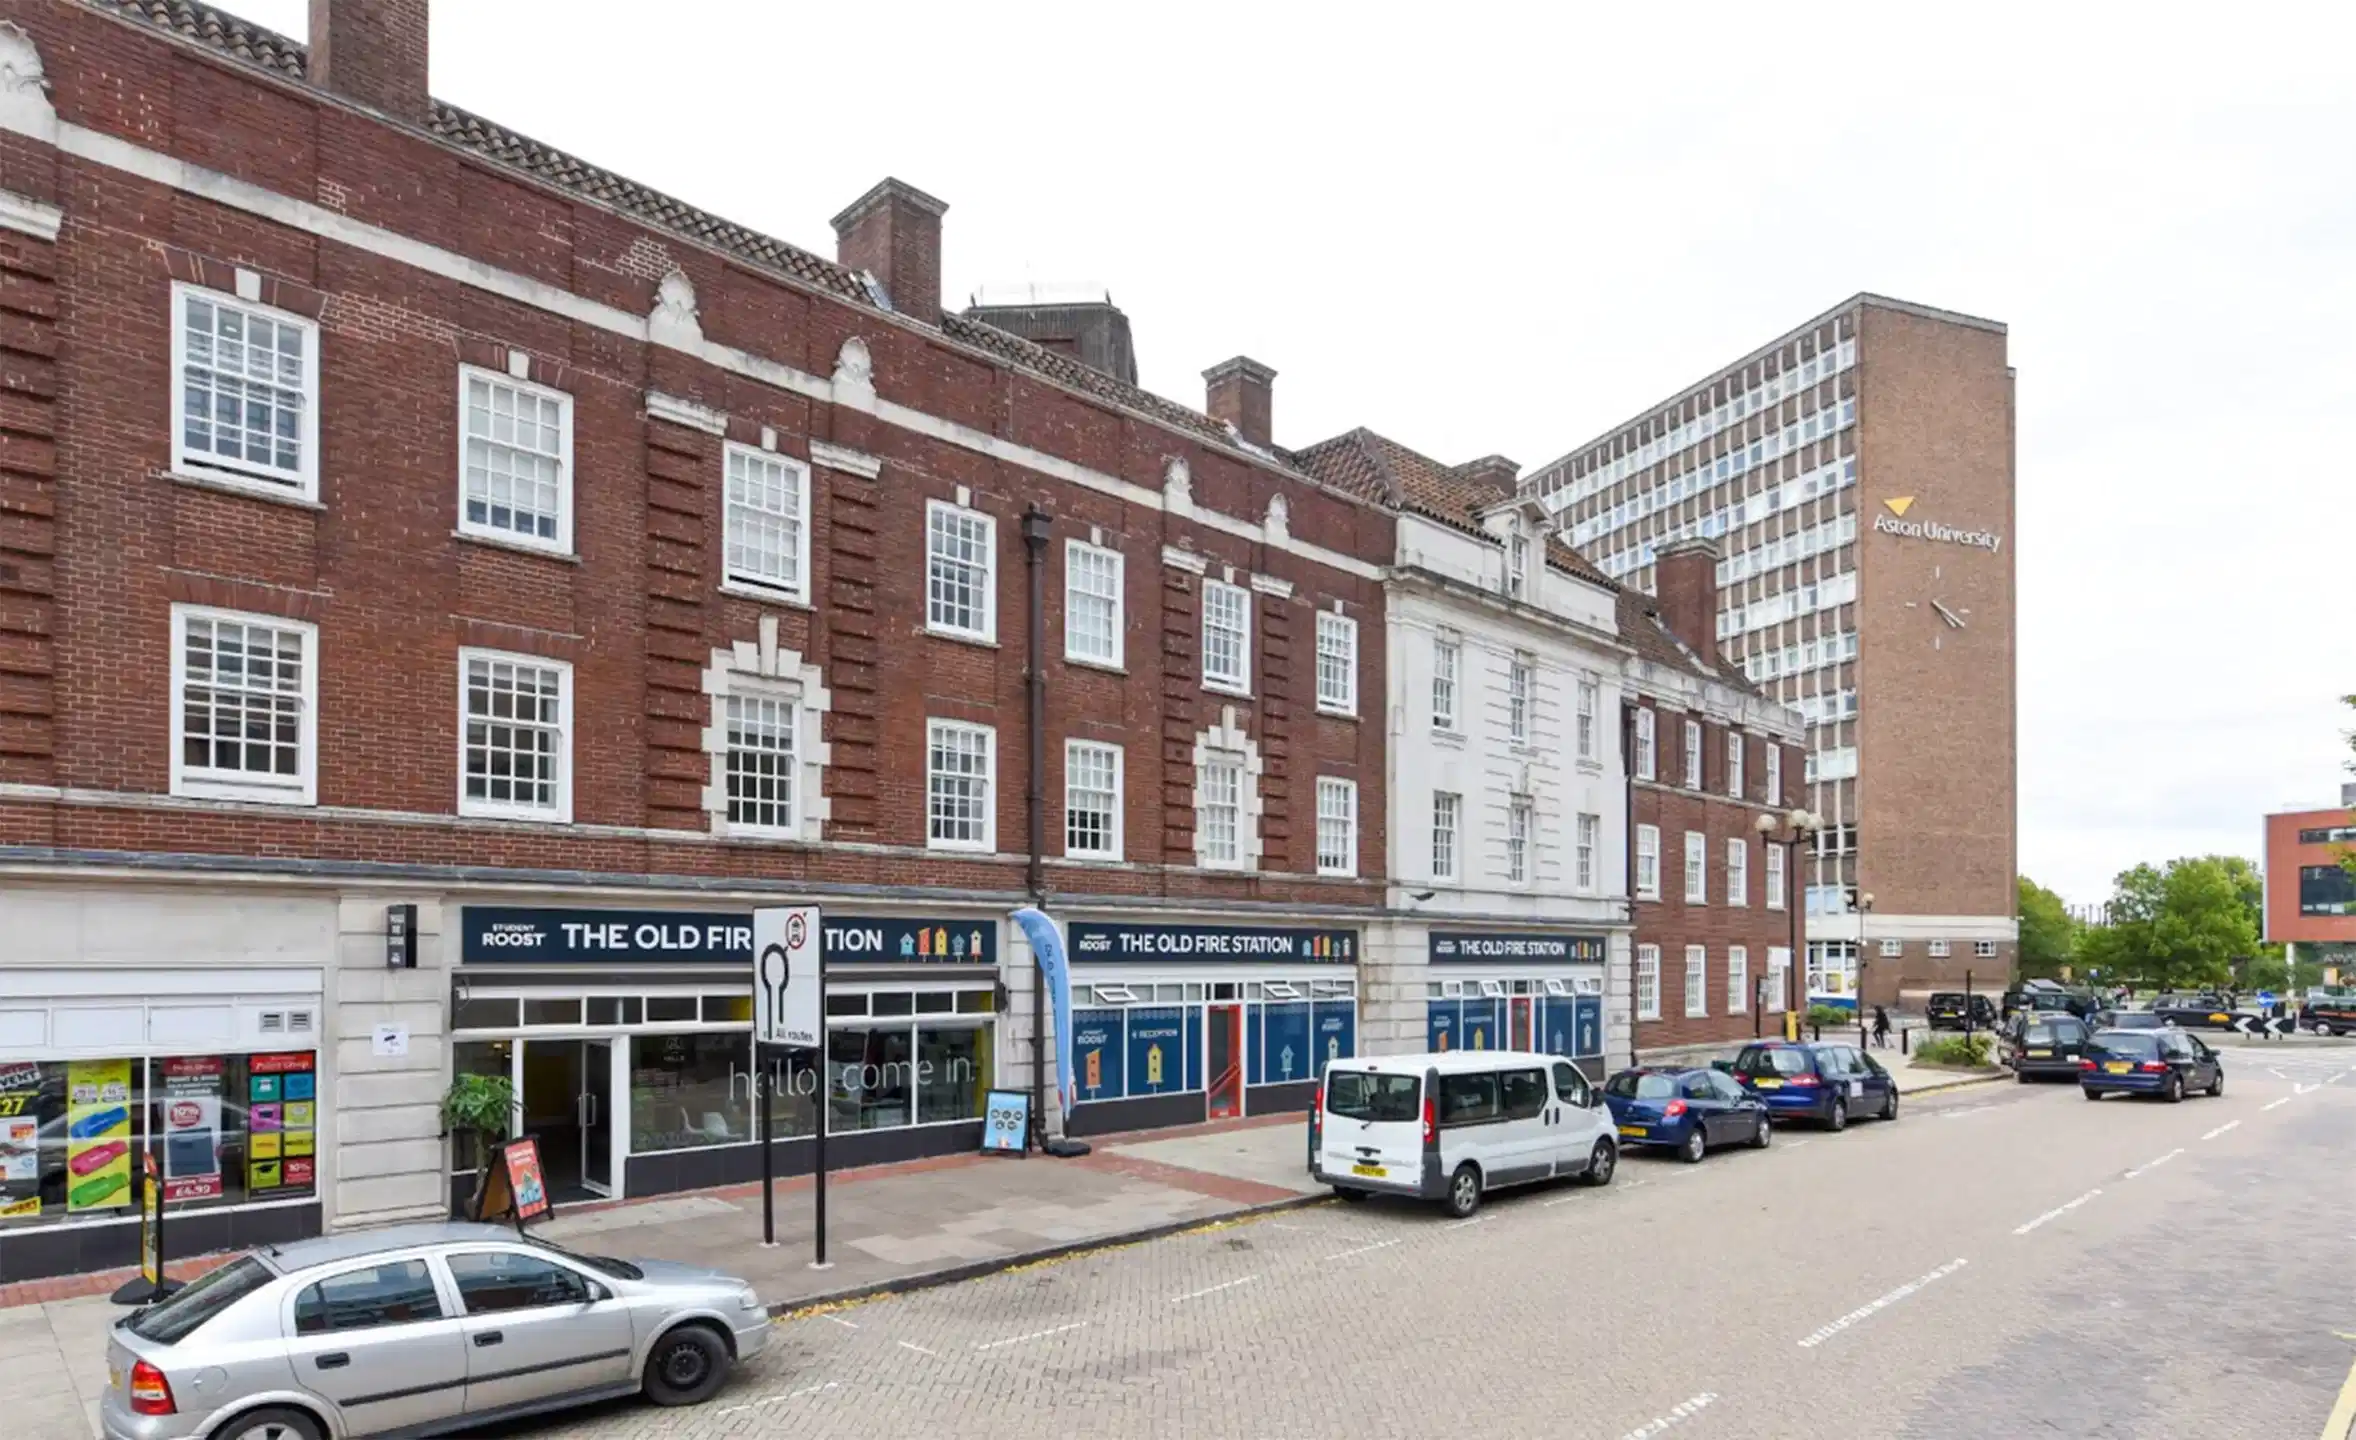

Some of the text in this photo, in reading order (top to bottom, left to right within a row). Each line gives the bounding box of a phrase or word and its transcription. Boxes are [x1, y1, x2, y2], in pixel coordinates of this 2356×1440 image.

[1873, 513, 2001, 553] Aston University
[481, 932, 548, 947] ROOST
[560, 923, 883, 952] THE OLD FIR TION
[1079, 940, 1112, 952] ROOST
[1118, 932, 1293, 954] THE OLD FIRE STATION
[1459, 939, 1482, 955] THE
[1482, 940, 1503, 956] OLD
[1504, 941, 1528, 956] FIRE
[1527, 941, 1566, 957] STATION
[788, 1030, 814, 1042] routes
[842, 1056, 934, 1091] come
